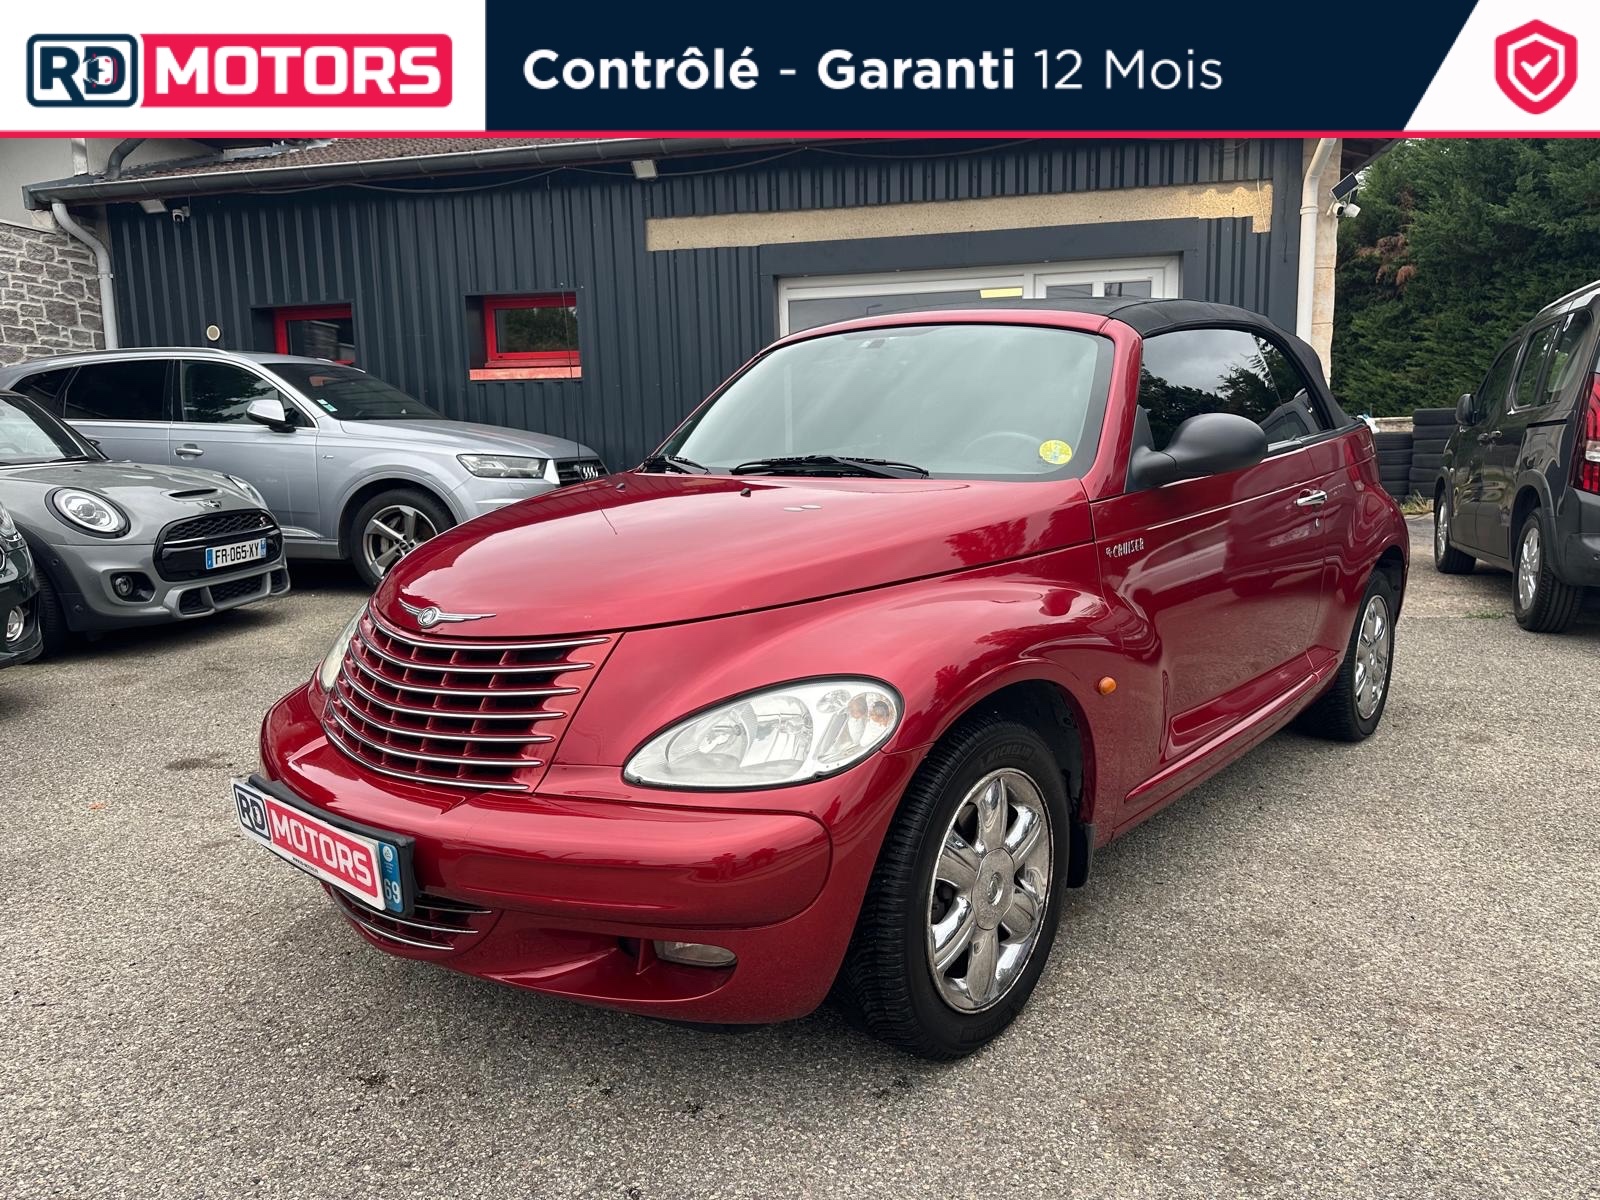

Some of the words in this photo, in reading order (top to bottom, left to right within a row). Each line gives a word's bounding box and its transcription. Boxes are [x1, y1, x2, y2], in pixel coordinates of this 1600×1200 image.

[215, 542, 259, 565] FR-065-XY
[237, 792, 266, 831] RD
[270, 808, 373, 887] MOTORS
[384, 878, 401, 904] 69
